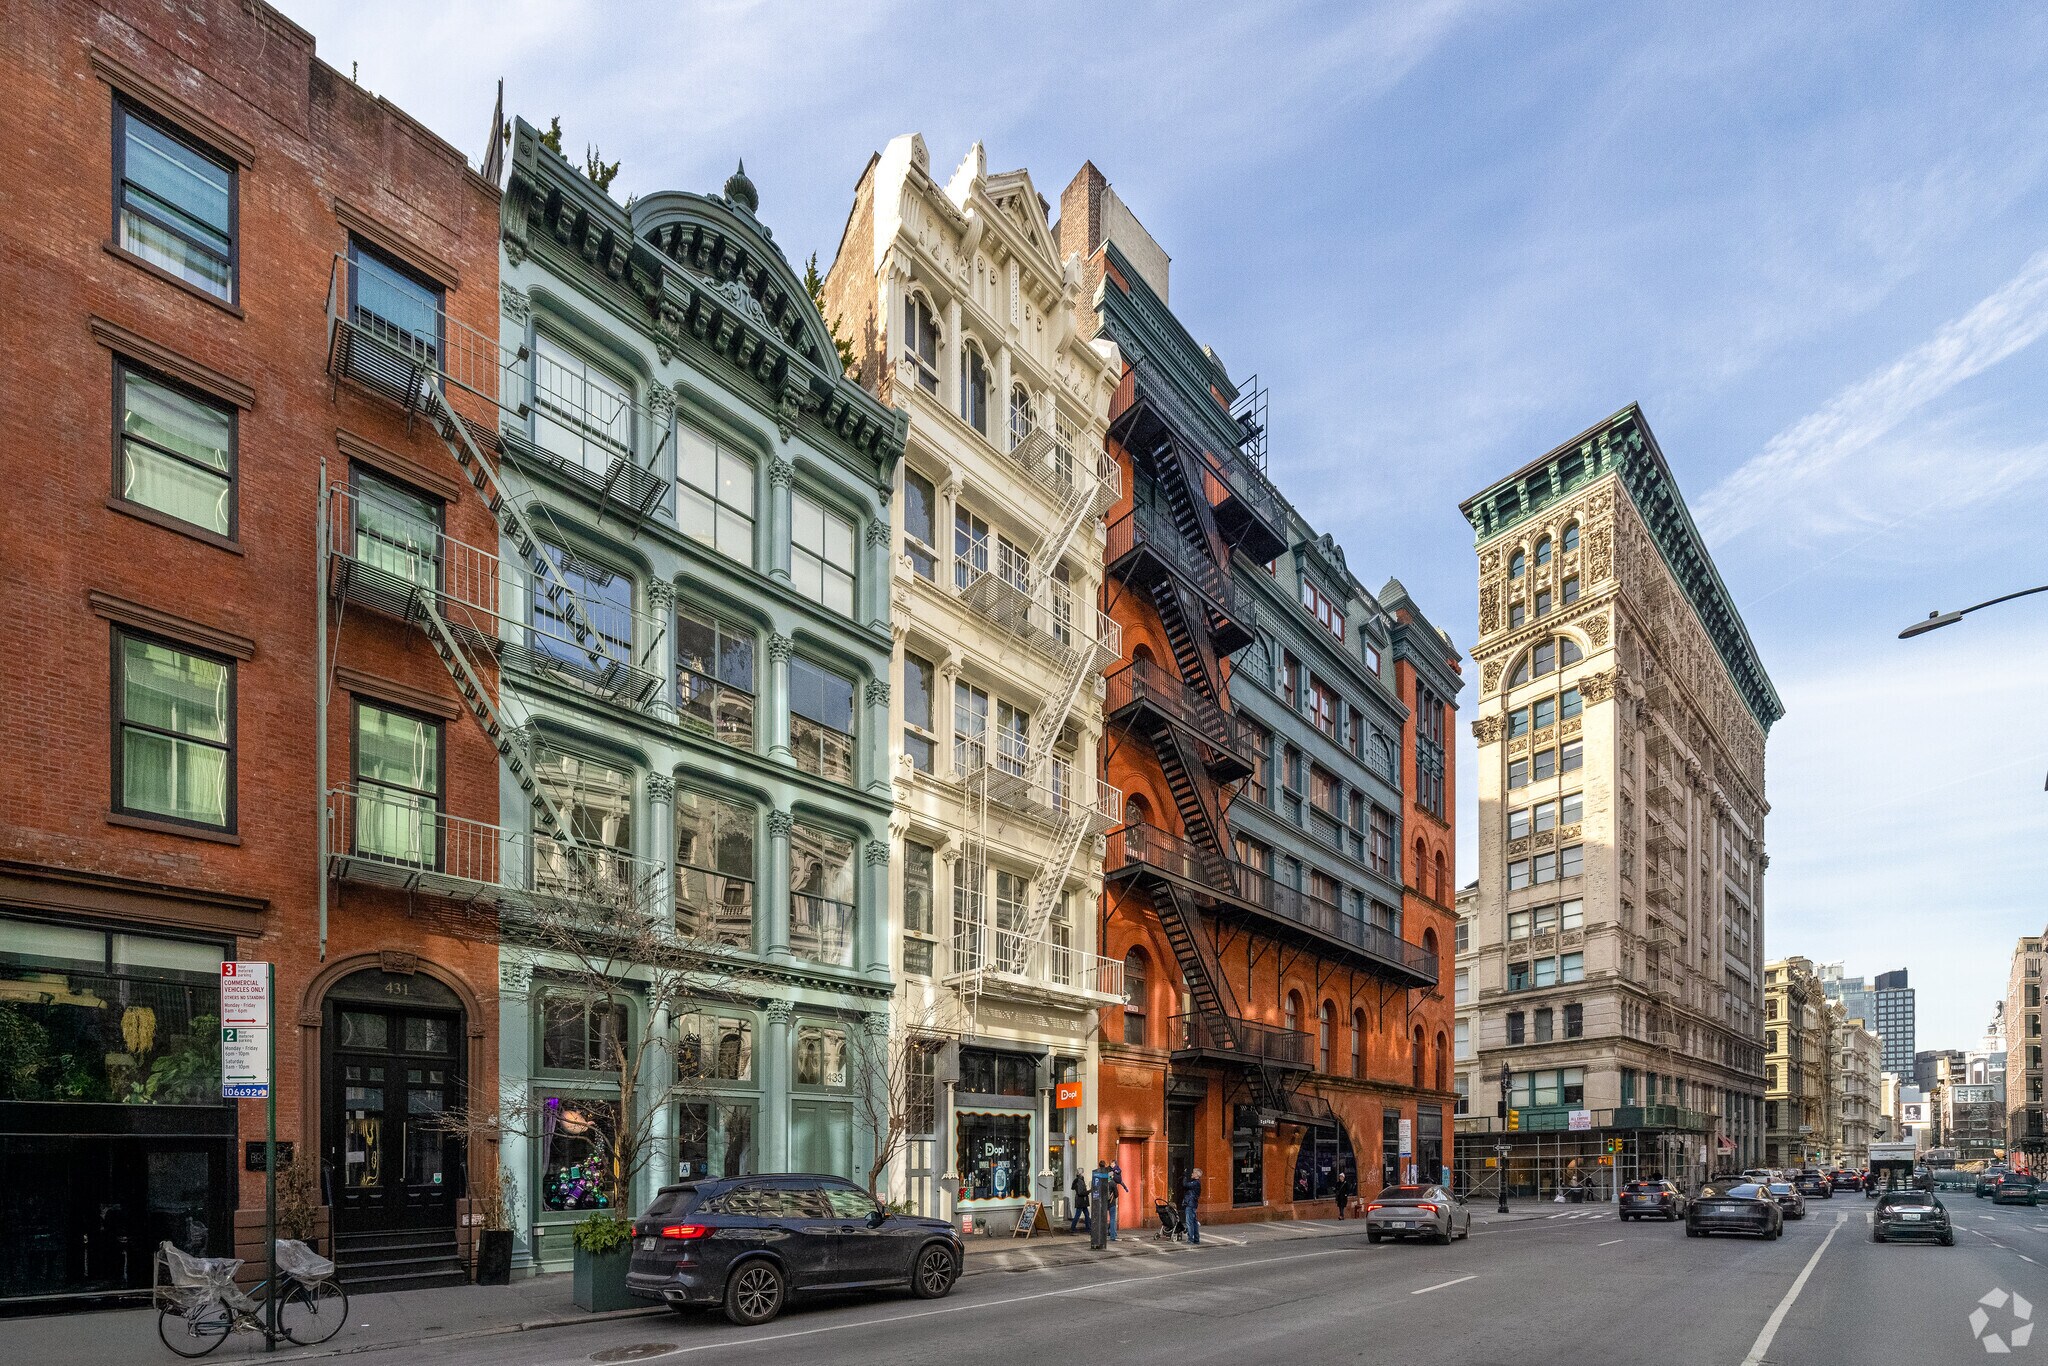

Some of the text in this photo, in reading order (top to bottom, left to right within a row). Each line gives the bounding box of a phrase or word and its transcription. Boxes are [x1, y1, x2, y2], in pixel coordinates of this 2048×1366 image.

[225, 964, 233, 976] 3
[385, 982, 408, 995] 431
[226, 1030, 234, 1041] 2
[827, 1073, 843, 1083] 433
[1061, 1090, 1077, 1100] Dopl
[985, 1143, 1005, 1156] Dopl
[681, 1164, 688, 1172] A
